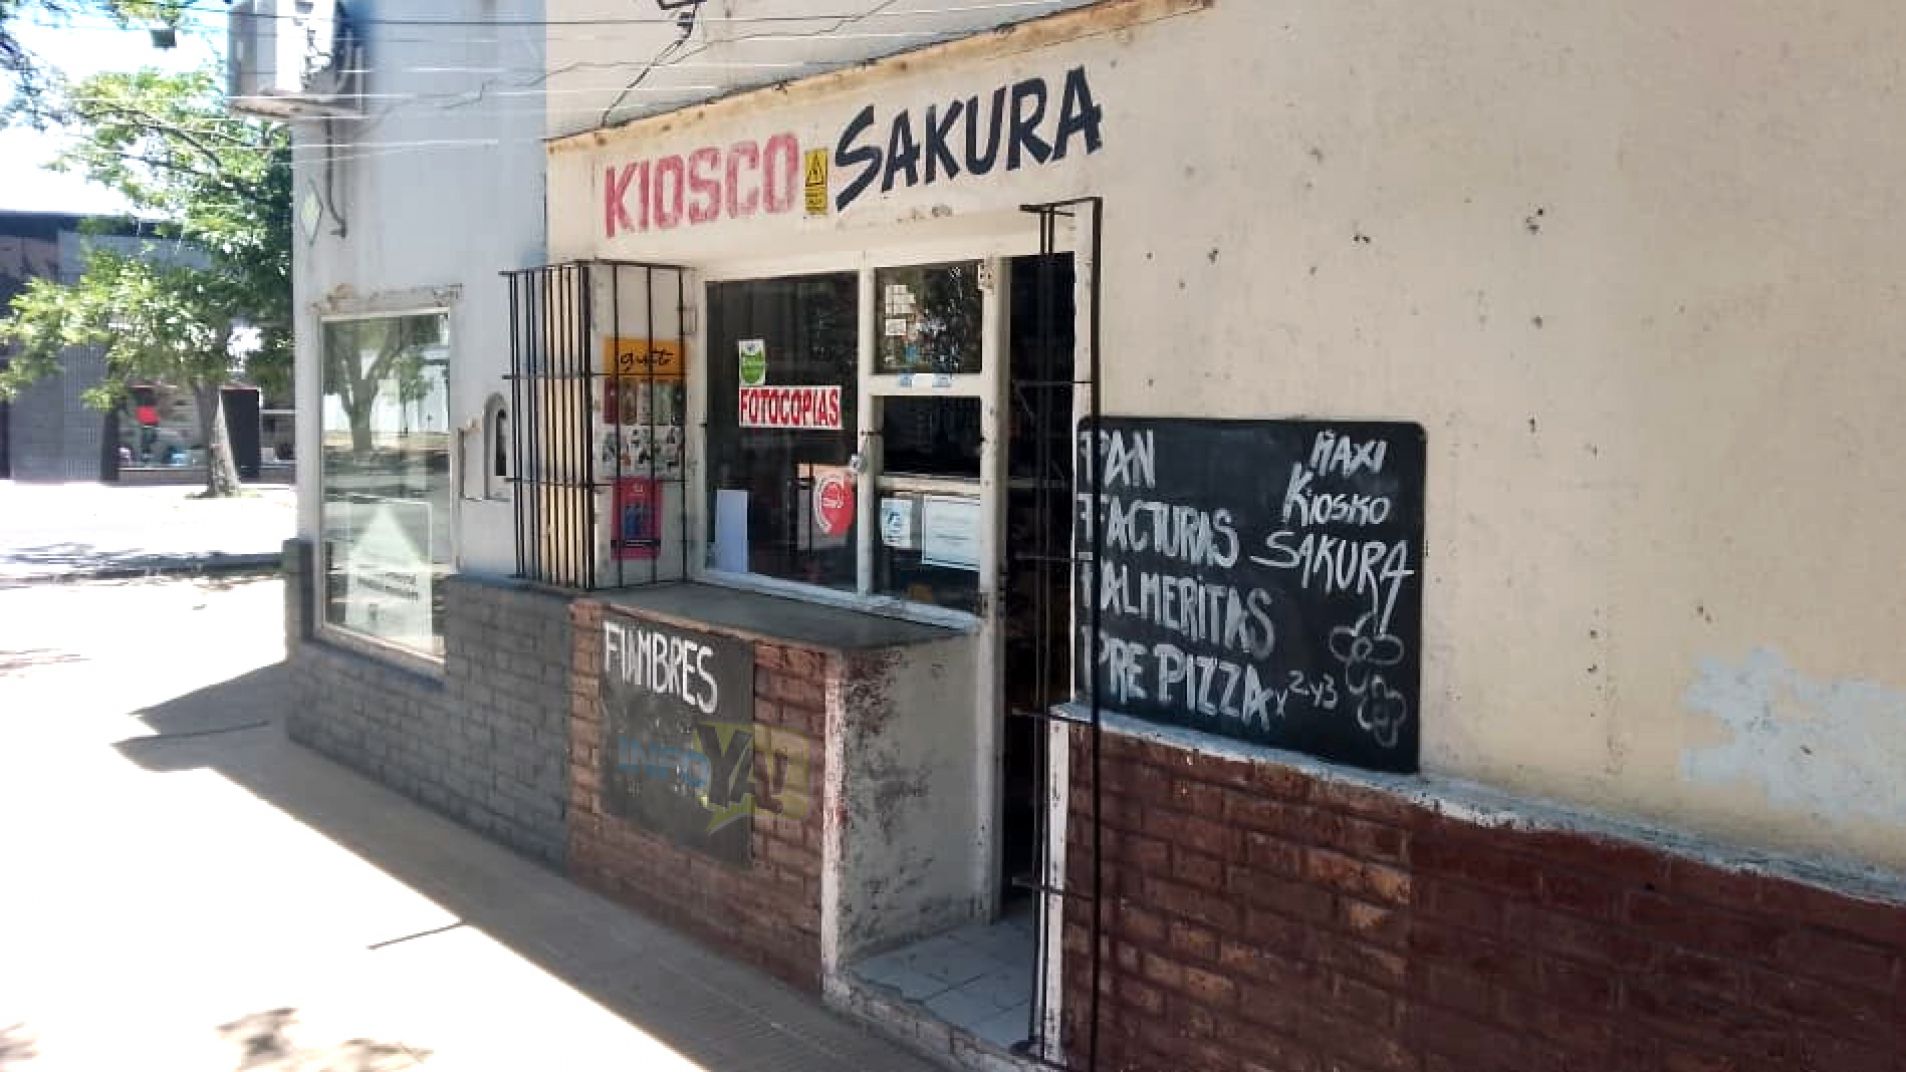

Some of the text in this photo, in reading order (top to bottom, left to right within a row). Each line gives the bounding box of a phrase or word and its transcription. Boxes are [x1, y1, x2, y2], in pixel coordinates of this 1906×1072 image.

[604, 66, 1102, 239] KIOSCO SAKURA
[740, 389, 839, 426] FOTOCOPIAS
[1079, 429, 1156, 488] PAN
[1310, 430, 1387, 477] MAXI
[1077, 493, 1239, 568] FACTURAS
[1250, 530, 1414, 625] SAKURA
[603, 621, 718, 714] FIAMBRES
[1081, 625, 1147, 704] PRE
[1153, 643, 1274, 732] PIZZA
